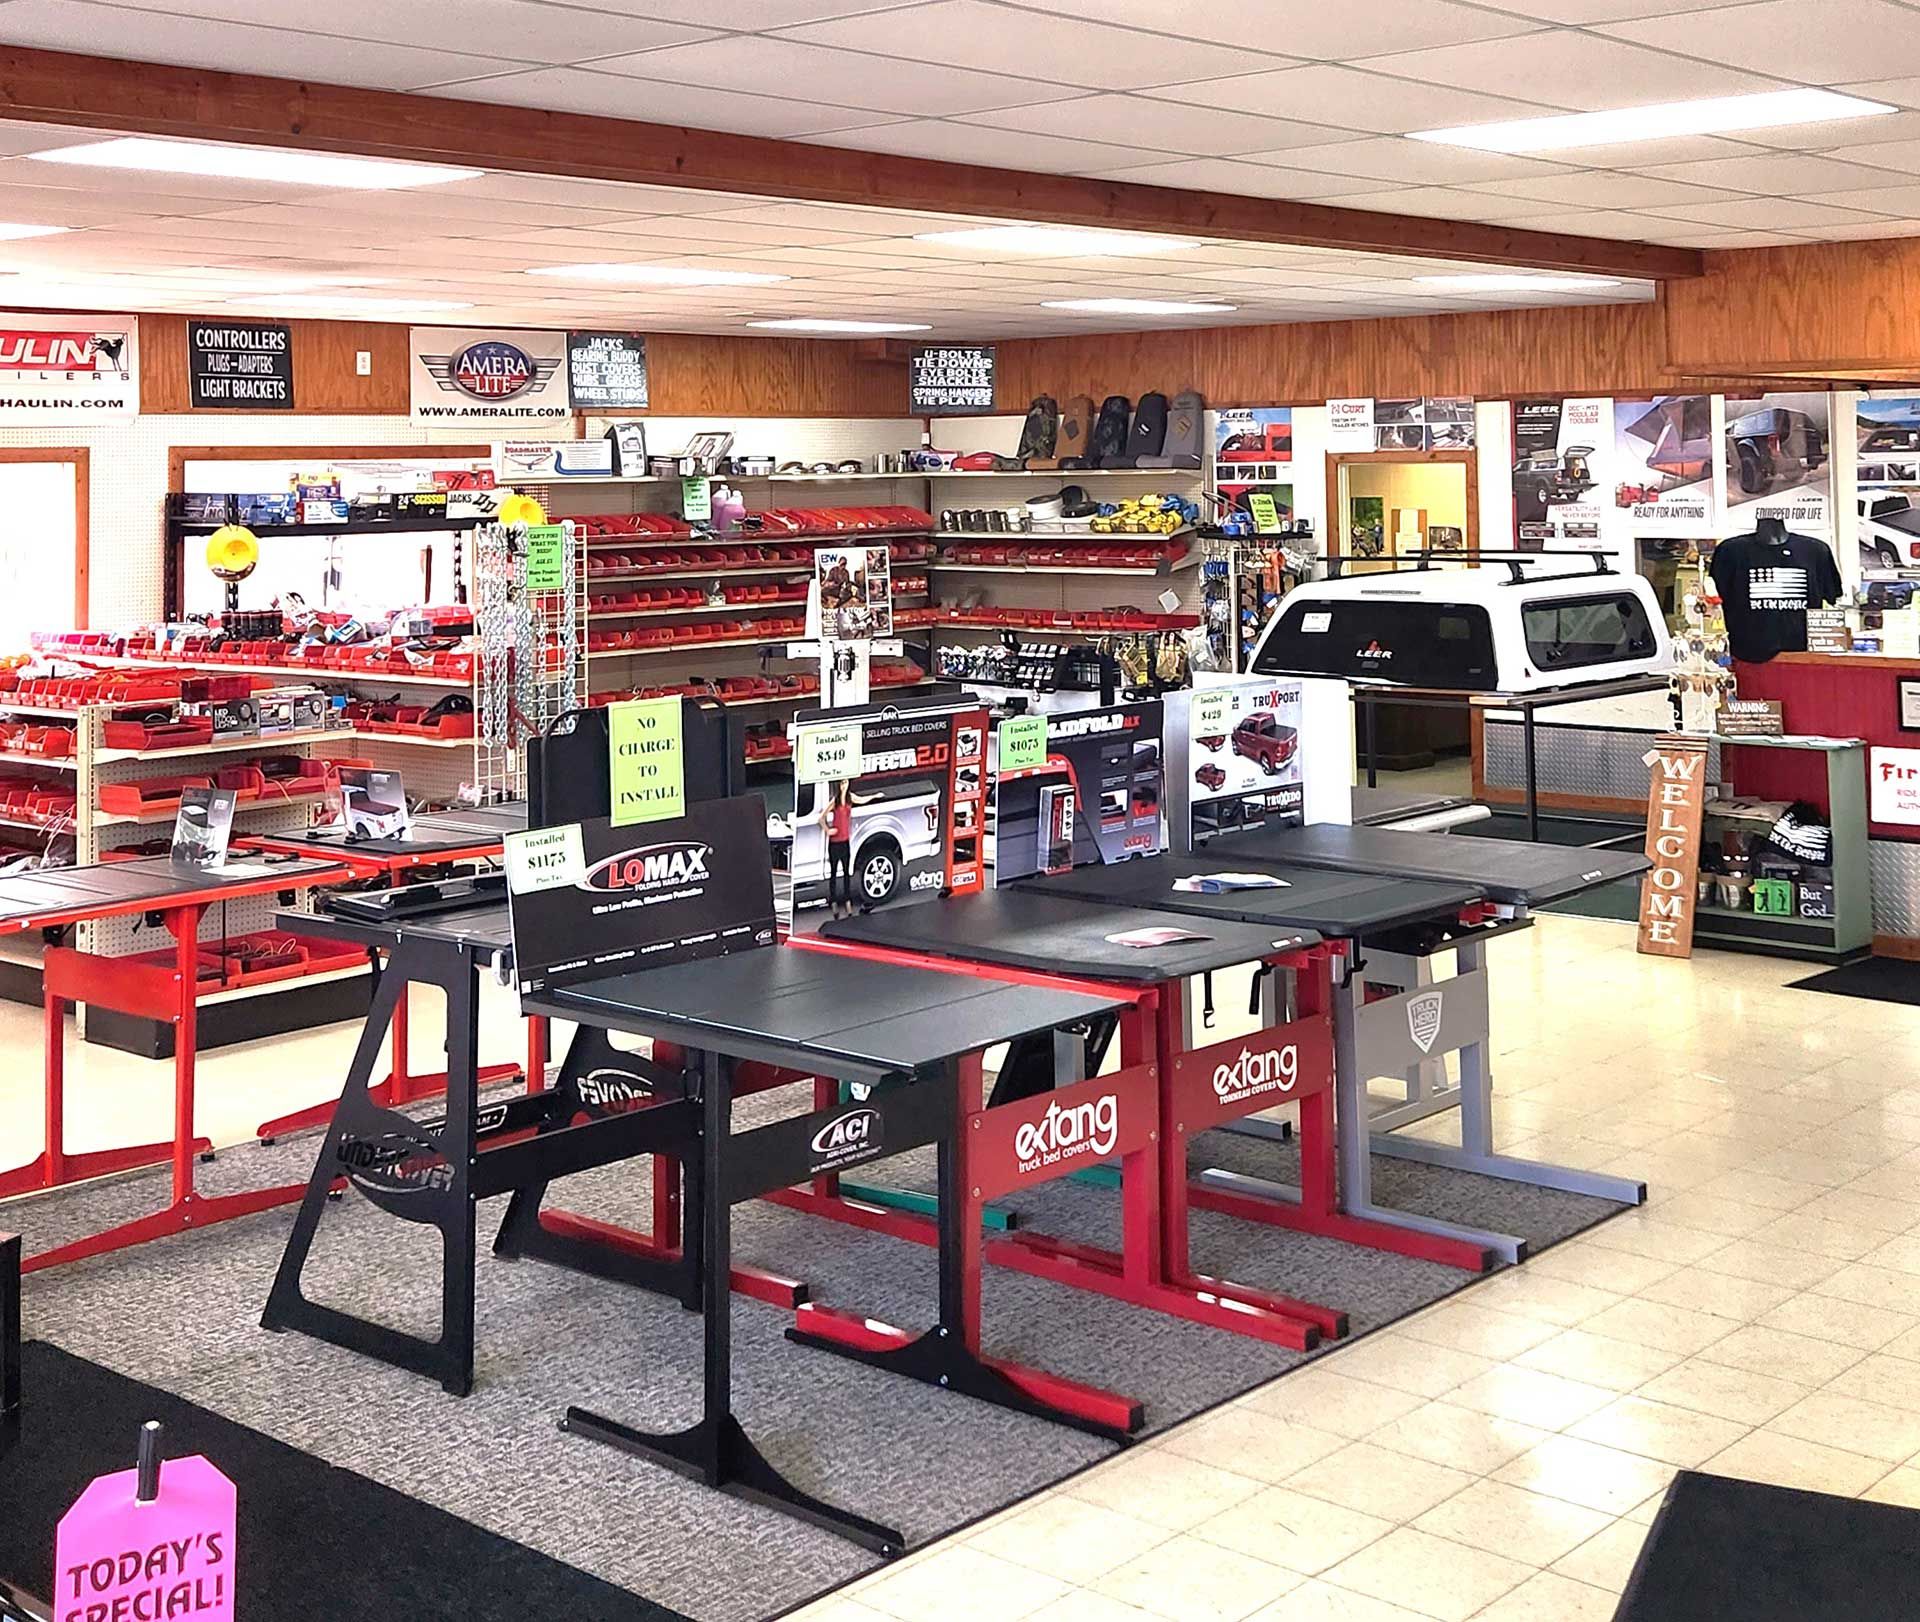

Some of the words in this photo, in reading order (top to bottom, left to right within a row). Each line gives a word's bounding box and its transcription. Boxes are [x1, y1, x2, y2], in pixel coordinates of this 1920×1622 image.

[196, 329, 286, 350] CONTROLLERS
[588, 337, 624, 351] JACKS
[571, 349, 609, 363] BEARING
[610, 350, 640, 364] BUDDY
[924, 349, 982, 359] U-BOLTS
[457, 353, 530, 377] AMERA
[571, 361, 599, 374] DUST
[601, 362, 641, 375] COVERS
[913, 358, 936, 368] TIE
[938, 359, 993, 369] DOWNS
[920, 368, 945, 377] EYE
[946, 368, 987, 378] BOLTS
[475, 376, 512, 394] LITE
[572, 374, 600, 386] HUBS
[605, 374, 642, 388] GREASE
[918, 376, 990, 387] SHACKLES
[200, 379, 231, 398] LIGHT
[232, 380, 286, 400] BRACKETS
[573, 387, 610, 400] WHEEL
[610, 388, 645, 401] STUDS
[912, 387, 948, 397] SPRING
[914, 396, 937, 405] TIE
[938, 396, 992, 406] PLATES
[419, 407, 566, 418] WWW.AMERALITE.COM
[1226, 411, 1254, 419] LEER
[1341, 404, 1366, 414] CURT
[1524, 405, 1560, 414] LEER
[449, 493, 473, 504] JACKS
[1633, 506, 1656, 518] READY
[1656, 506, 1670, 518] FOR
[1670, 506, 1705, 518] ANYTHING
[1792, 507, 1807, 519] FOR
[1807, 507, 1823, 520] LIFE
[1355, 649, 1393, 660] LEER
[1252, 690, 1300, 708] TRUXPORT
[637, 716, 656, 729] NO
[1201, 709, 1222, 721] $429
[866, 727, 892, 739] SELLING
[891, 725, 911, 735] TRUCK
[911, 723, 924, 733] BED
[924, 721, 948, 732] COVERS
[1009, 723, 1039, 735] Installed
[815, 733, 849, 745] Installed
[1009, 738, 1039, 752] $1075
[618, 737, 676, 757] CHARGE
[917, 743, 949, 765] 2.0
[637, 764, 658, 778] TO
[620, 785, 679, 805] INSTALL
[1266, 790, 1302, 806] TRUXEDO
[525, 832, 566, 849] Installed
[1646, 754, 1704, 944] WELCOME
[528, 851, 566, 870] $1175
[608, 847, 708, 888] LOMAX
[634, 880, 662, 892] FOLDING
[662, 877, 680, 888] HARD
[689, 871, 710, 882] COVER
[910, 871, 945, 890] extang
[1799, 886, 1823, 901] But
[1800, 902, 1828, 917] God
[1414, 1010, 1437, 1028] HERO
[1213, 1045, 1298, 1096] extang
[1251, 1080, 1277, 1095] COVERS
[828, 1114, 870, 1148] ACI
[1015, 1094, 1118, 1161] extang
[1018, 1154, 1042, 1174] truck
[1042, 1147, 1061, 1166] bed
[1061, 1140, 1091, 1159] covers
[66, 1532, 223, 1600] TODAY'S
[64, 1572, 223, 1622] SPECIAL!
